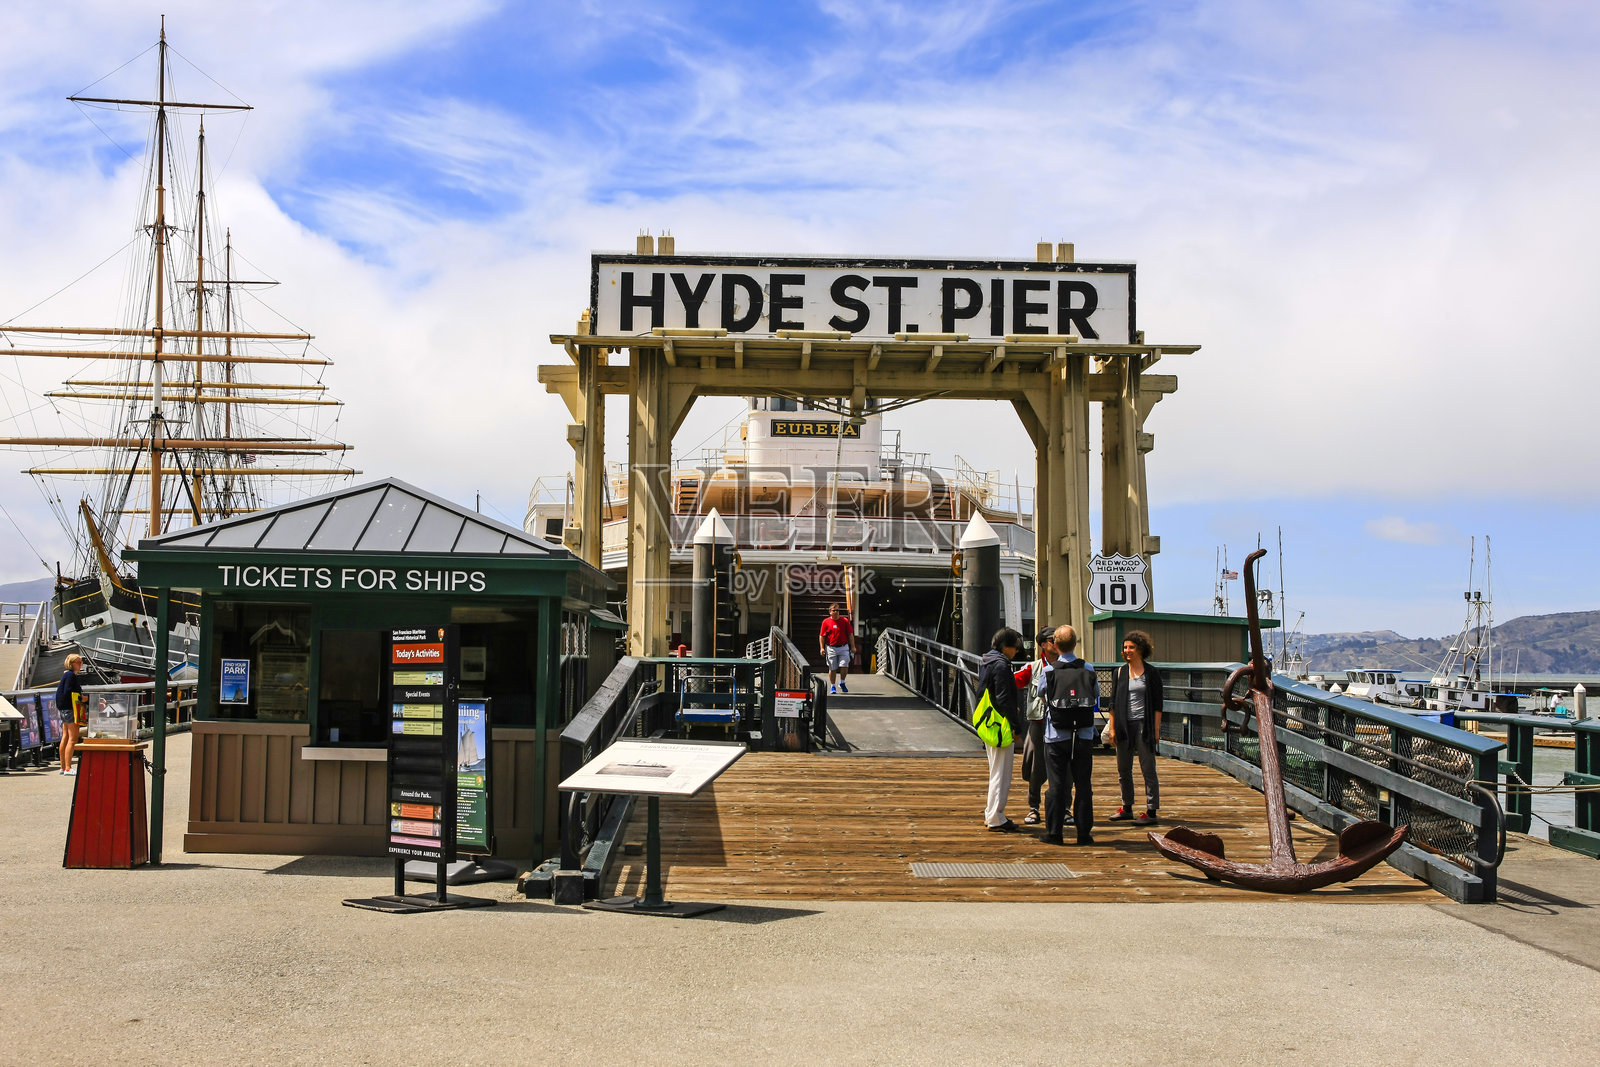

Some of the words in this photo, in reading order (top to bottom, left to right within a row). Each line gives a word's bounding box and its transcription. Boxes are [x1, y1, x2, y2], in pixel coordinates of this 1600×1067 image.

[619, 271, 807, 333] HYDE
[828, 273, 919, 334] ST.
[942, 276, 1101, 341] PIER
[775, 422, 858, 435] EUREKA
[218, 565, 332, 588] TICKETS
[341, 568, 397, 590] FOR
[405, 569, 486, 592] SHIPS
[1100, 583, 1137, 606] 101
[396, 649, 415, 660] Today's
[415, 649, 440, 658] Activities
[224, 666, 246, 675] PARK
[405, 691, 418, 699] Special
[458, 705, 480, 720] iling
[401, 790, 415, 798] Around
[388, 847, 411, 855] EXPERIENCE
